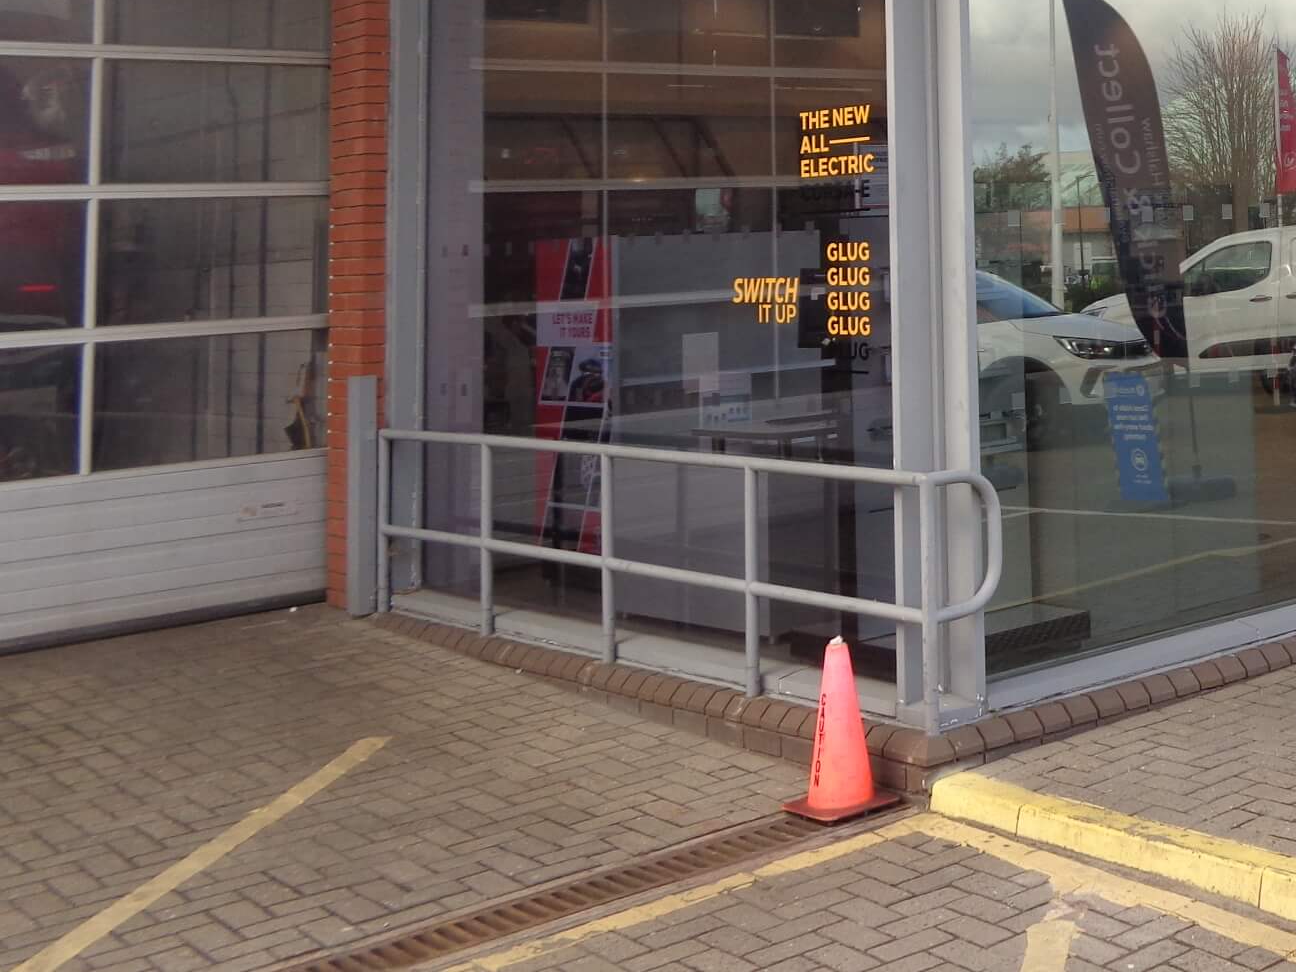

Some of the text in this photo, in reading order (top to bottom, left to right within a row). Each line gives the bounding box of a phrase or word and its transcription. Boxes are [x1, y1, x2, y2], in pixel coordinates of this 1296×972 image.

[800, 105, 870, 130] THE NEW
[800, 134, 830, 154] ALL
[800, 154, 875, 178] ELECTRIC
[827, 242, 870, 261] GLUG
[827, 267, 870, 286] GLUG
[732, 277, 799, 304] SWITCH
[827, 291, 870, 311] GLUG
[758, 303, 797, 324] IT UP
[827, 316, 870, 336] GLUG
[813, 693, 827, 788] CAUTION
